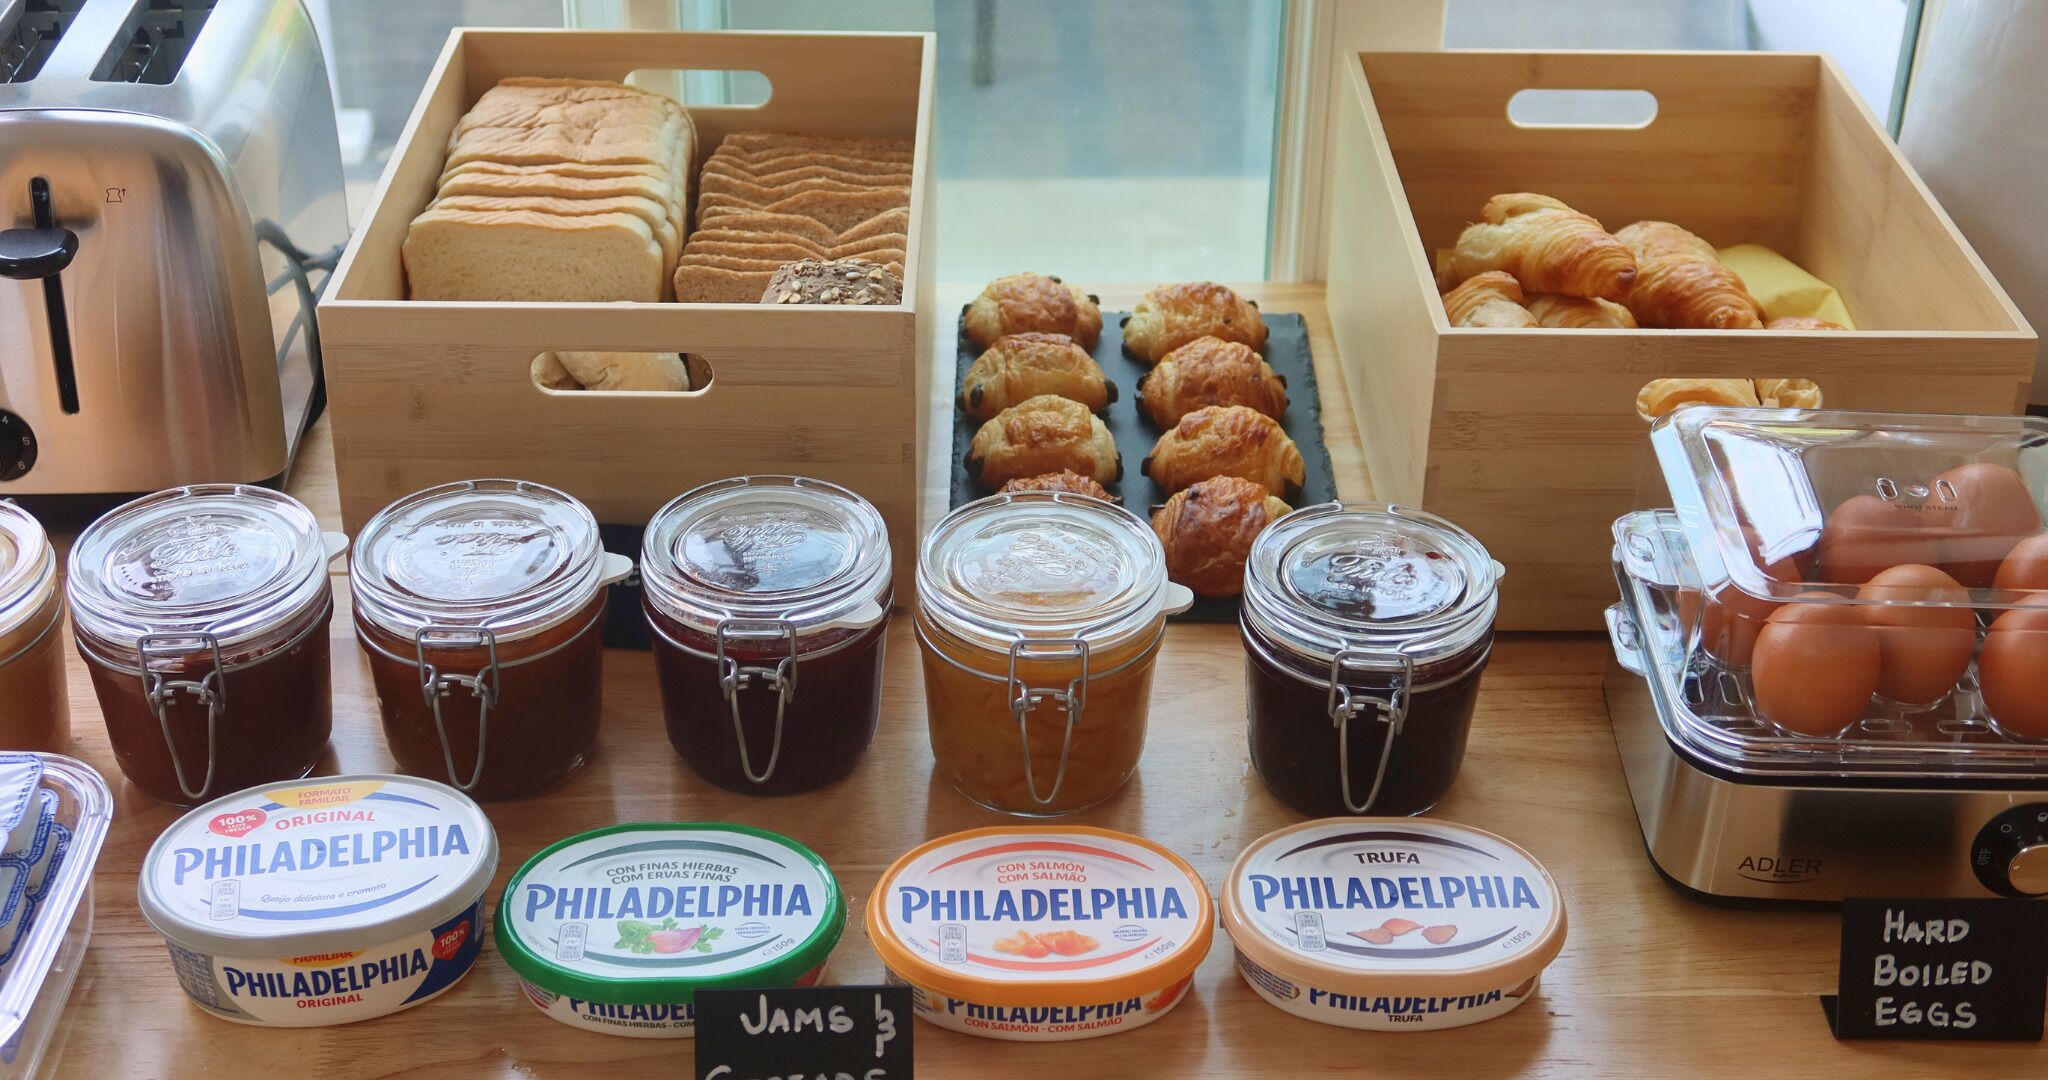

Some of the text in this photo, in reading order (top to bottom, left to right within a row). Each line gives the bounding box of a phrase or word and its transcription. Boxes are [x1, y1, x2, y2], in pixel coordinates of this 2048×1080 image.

[22, 436, 30, 446] 5
[298, 787, 351, 798] FORMATO
[300, 796, 349, 806] FAMILIAR
[218, 814, 257, 826] 100%
[275, 810, 376, 830] ORIGINAL
[173, 824, 470, 886] PHILADELPHIA
[1354, 852, 1421, 865] TRUFA
[606, 861, 740, 877] CON FINAS HIERBAS
[996, 861, 1086, 874] CON SALMÓN
[1738, 856, 1822, 874] ADLER
[612, 870, 732, 885] COM ERVAS FINAS
[997, 871, 1087, 884] COM SALMÃO
[260, 894, 291, 904] Queijo
[294, 893, 336, 903] delicioso
[346, 882, 386, 897] cremoso
[1248, 874, 1541, 912] PHILADELPHIA
[524, 884, 812, 922] PHILADELPHIA
[898, 886, 1189, 924] PHILADELPHIA
[1882, 908, 1970, 946] HARD
[440, 928, 465, 948] 100%
[772, 938, 796, 952] 150g
[1510, 930, 1532, 944] 150g
[1153, 940, 1176, 956] 150g
[222, 948, 428, 998] PHILADELPHIA
[1874, 954, 1993, 988] BOILED
[296, 993, 364, 1009] ORIGINAL
[740, 992, 854, 1036] JAMS
[1388, 1014, 1424, 1023] TRUFA
[1874, 996, 1978, 1030] EGGS
[582, 1014, 600, 1023] CON
[602, 1018, 628, 1028] FINAS
[629, 1021, 667, 1029] HIERBAS
[964, 1018, 990, 1028] CON
[991, 1022, 1039, 1033] SALMÓN
[1048, 1024, 1075, 1033] COM
[1077, 1016, 1122, 1031] SALMÃO
